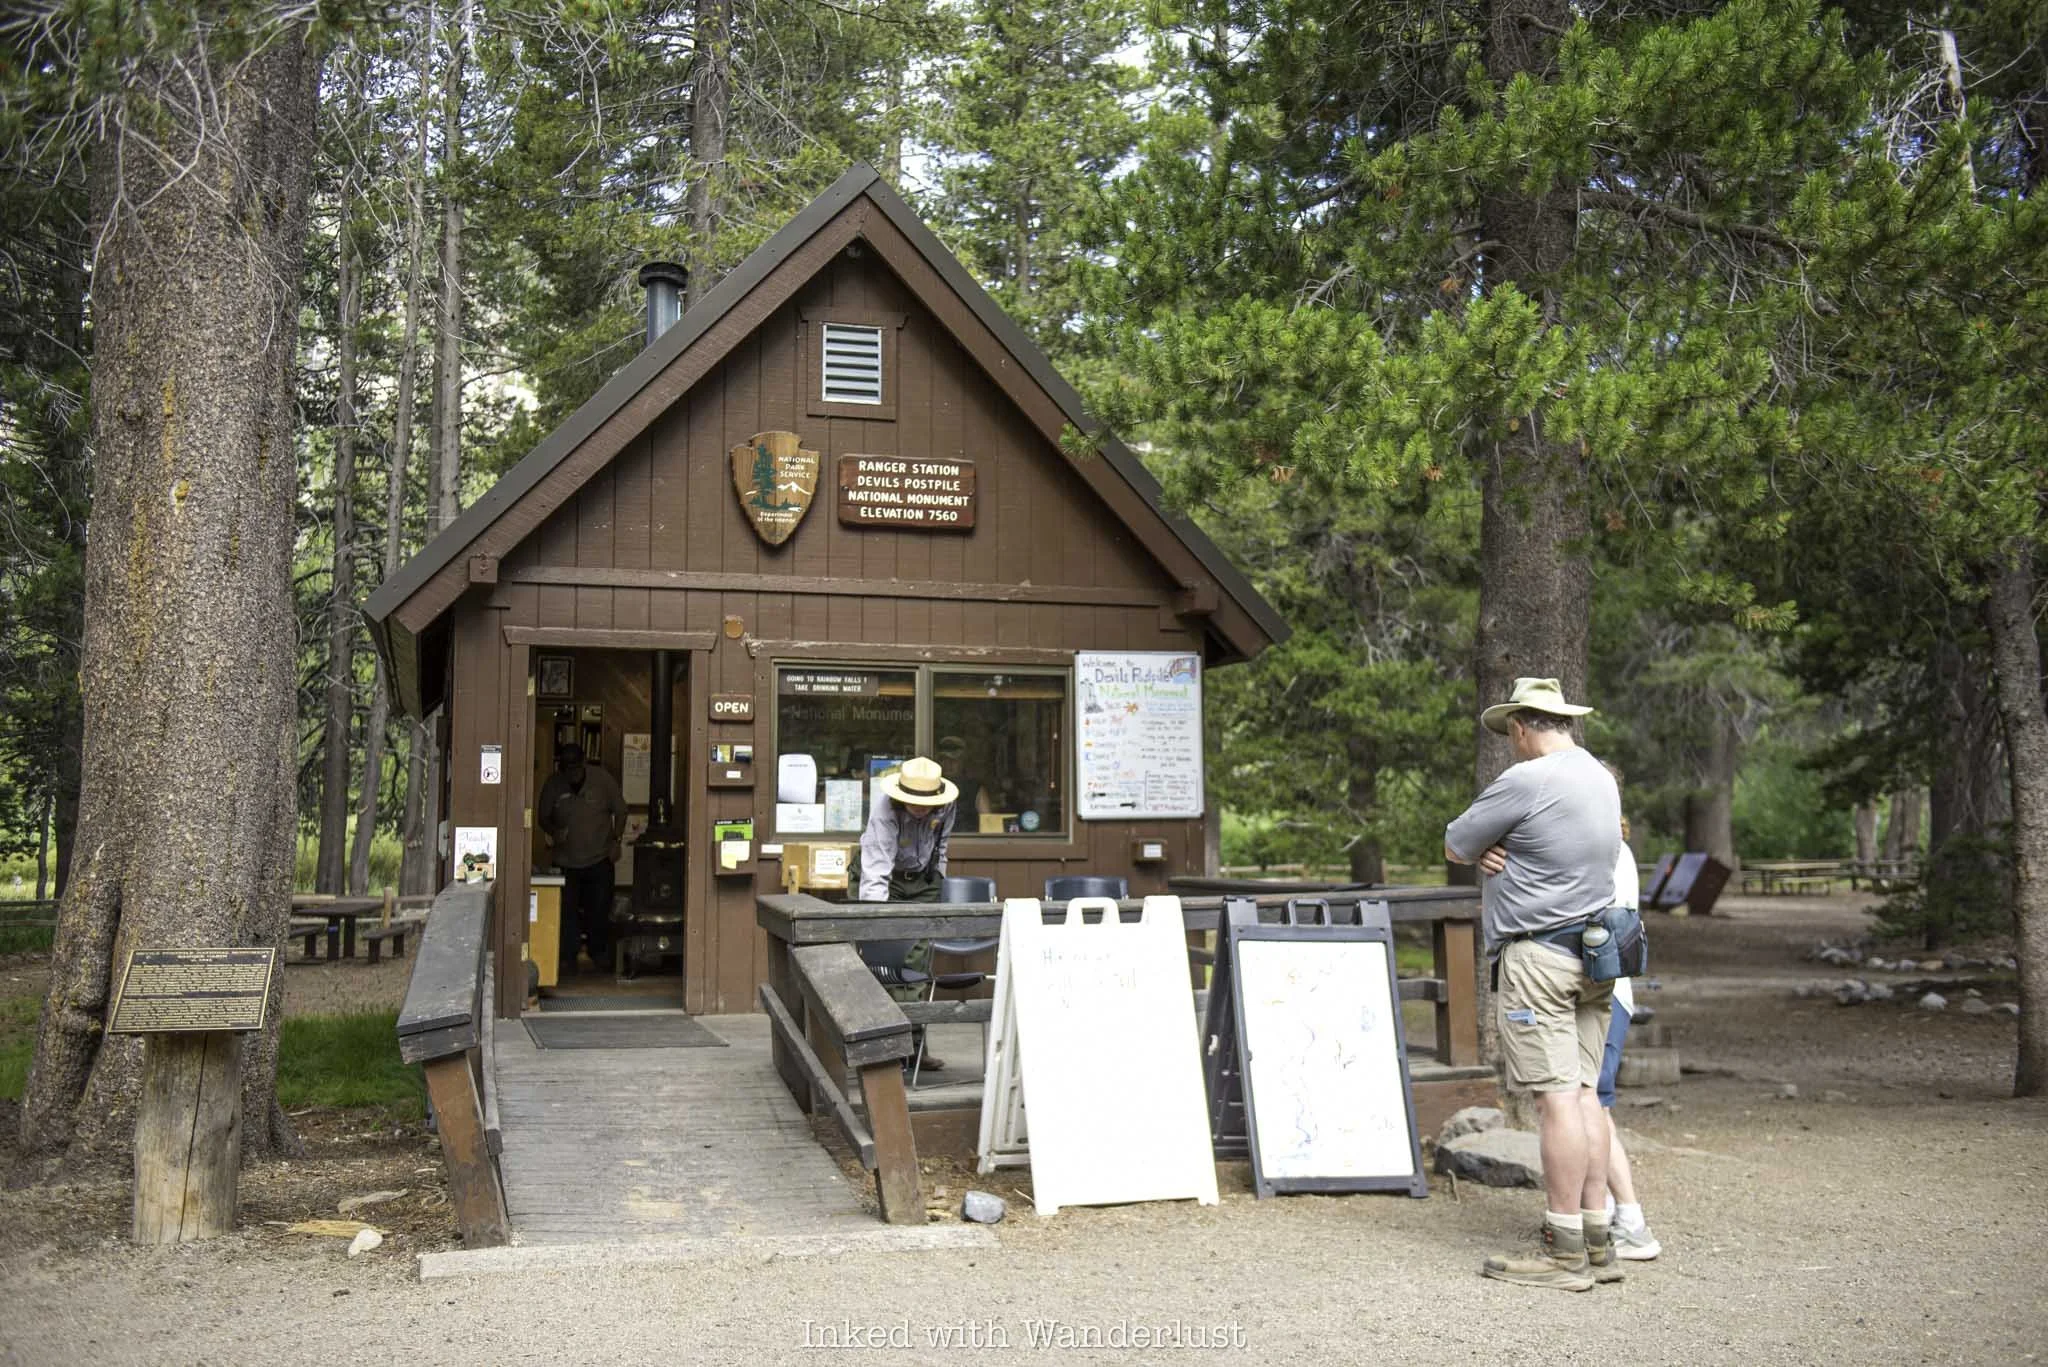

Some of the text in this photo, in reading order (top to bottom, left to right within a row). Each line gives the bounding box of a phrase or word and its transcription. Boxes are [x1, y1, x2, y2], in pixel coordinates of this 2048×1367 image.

[778, 456, 815, 464] NATIONAL
[785, 463, 805, 471] PARK
[858, 460, 960, 476] RANGER STATION
[779, 470, 811, 479] SERVICE
[857, 475, 961, 492] DEVILS POSTPILE
[848, 490, 969, 507] NATIONAL MONUMENT
[860, 506, 958, 522] ELEVATION 7560
[794, 683, 808, 691] TAKE
[812, 684, 838, 692] DRINKING
[714, 700, 749, 713] OPEN
